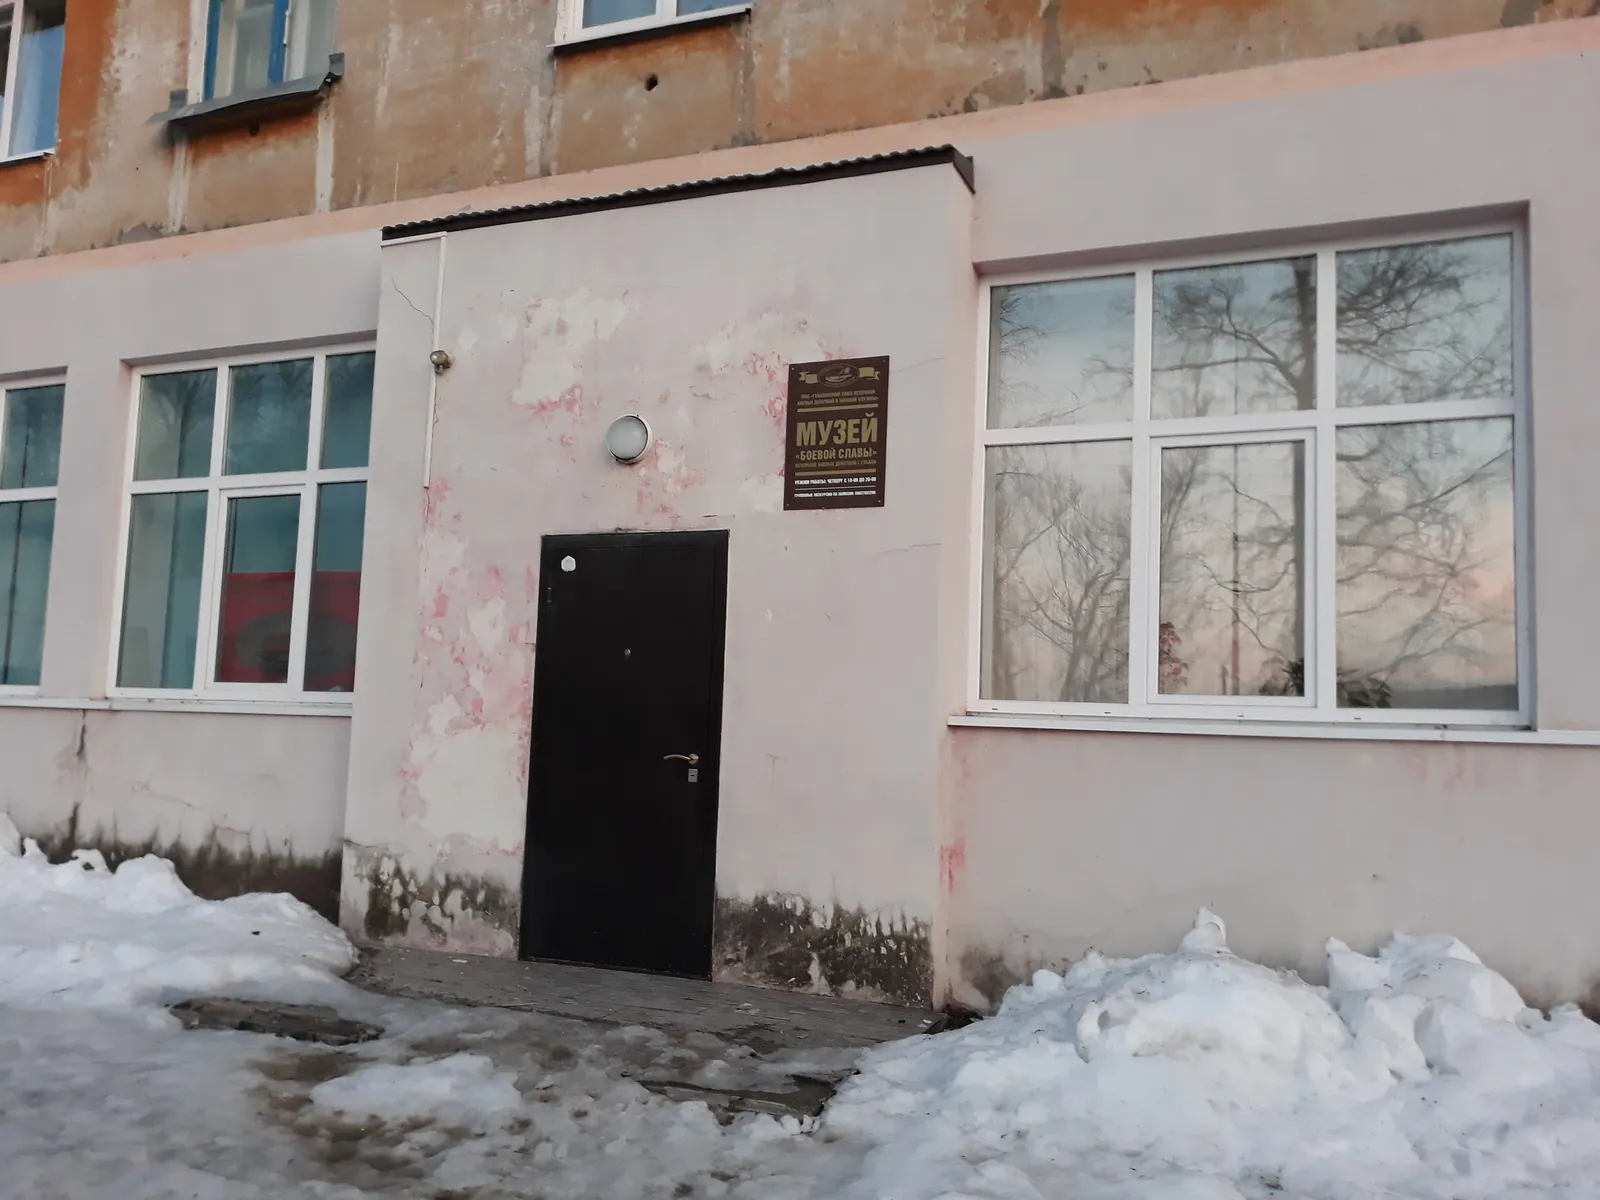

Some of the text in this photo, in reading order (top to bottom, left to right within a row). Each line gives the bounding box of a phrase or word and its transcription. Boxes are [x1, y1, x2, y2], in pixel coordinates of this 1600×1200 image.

[796, 412, 878, 446] МУЗЕЙ
[795, 447, 877, 460] «БОЕВОЙ СЛАВЫ»
